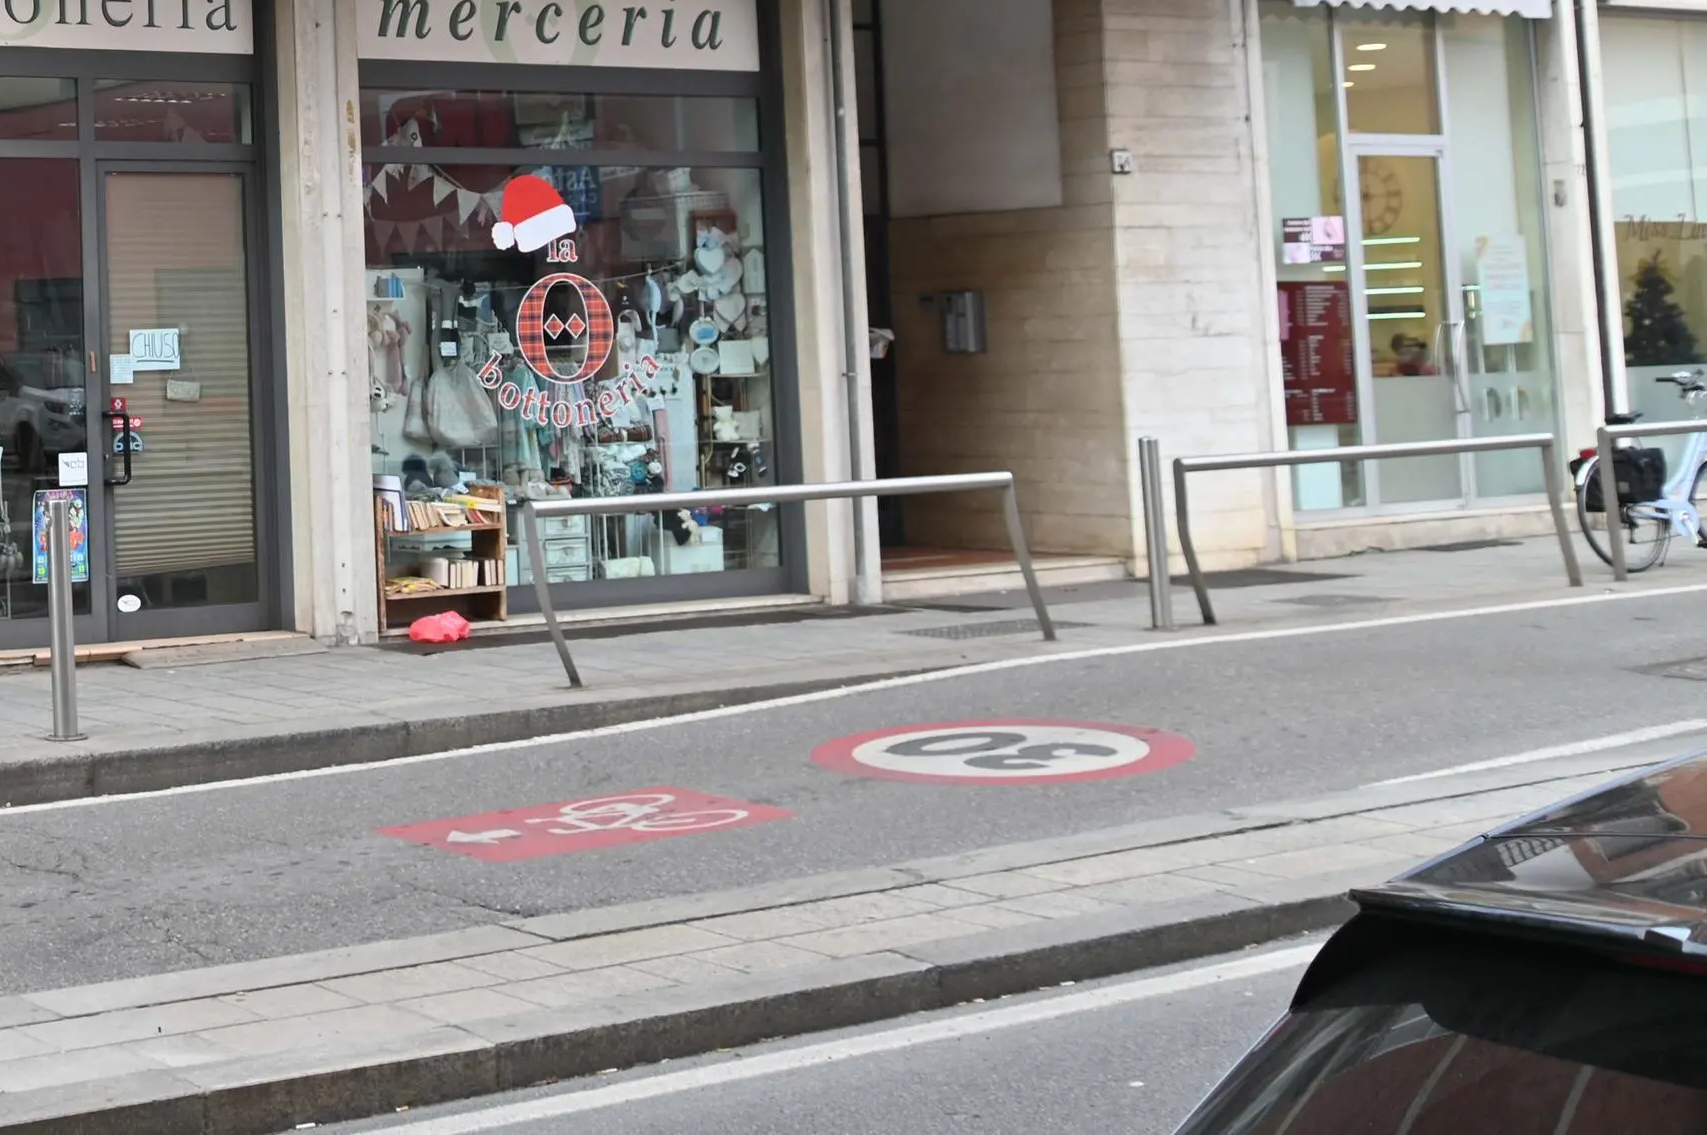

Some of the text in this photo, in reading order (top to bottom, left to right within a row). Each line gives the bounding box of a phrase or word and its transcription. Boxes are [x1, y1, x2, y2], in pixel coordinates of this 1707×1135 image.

[546, 237, 579, 263] la
[132, 331, 180, 359] CHIUSO
[476, 349, 662, 429] bottoneria
[882, 731, 1119, 771] 30
